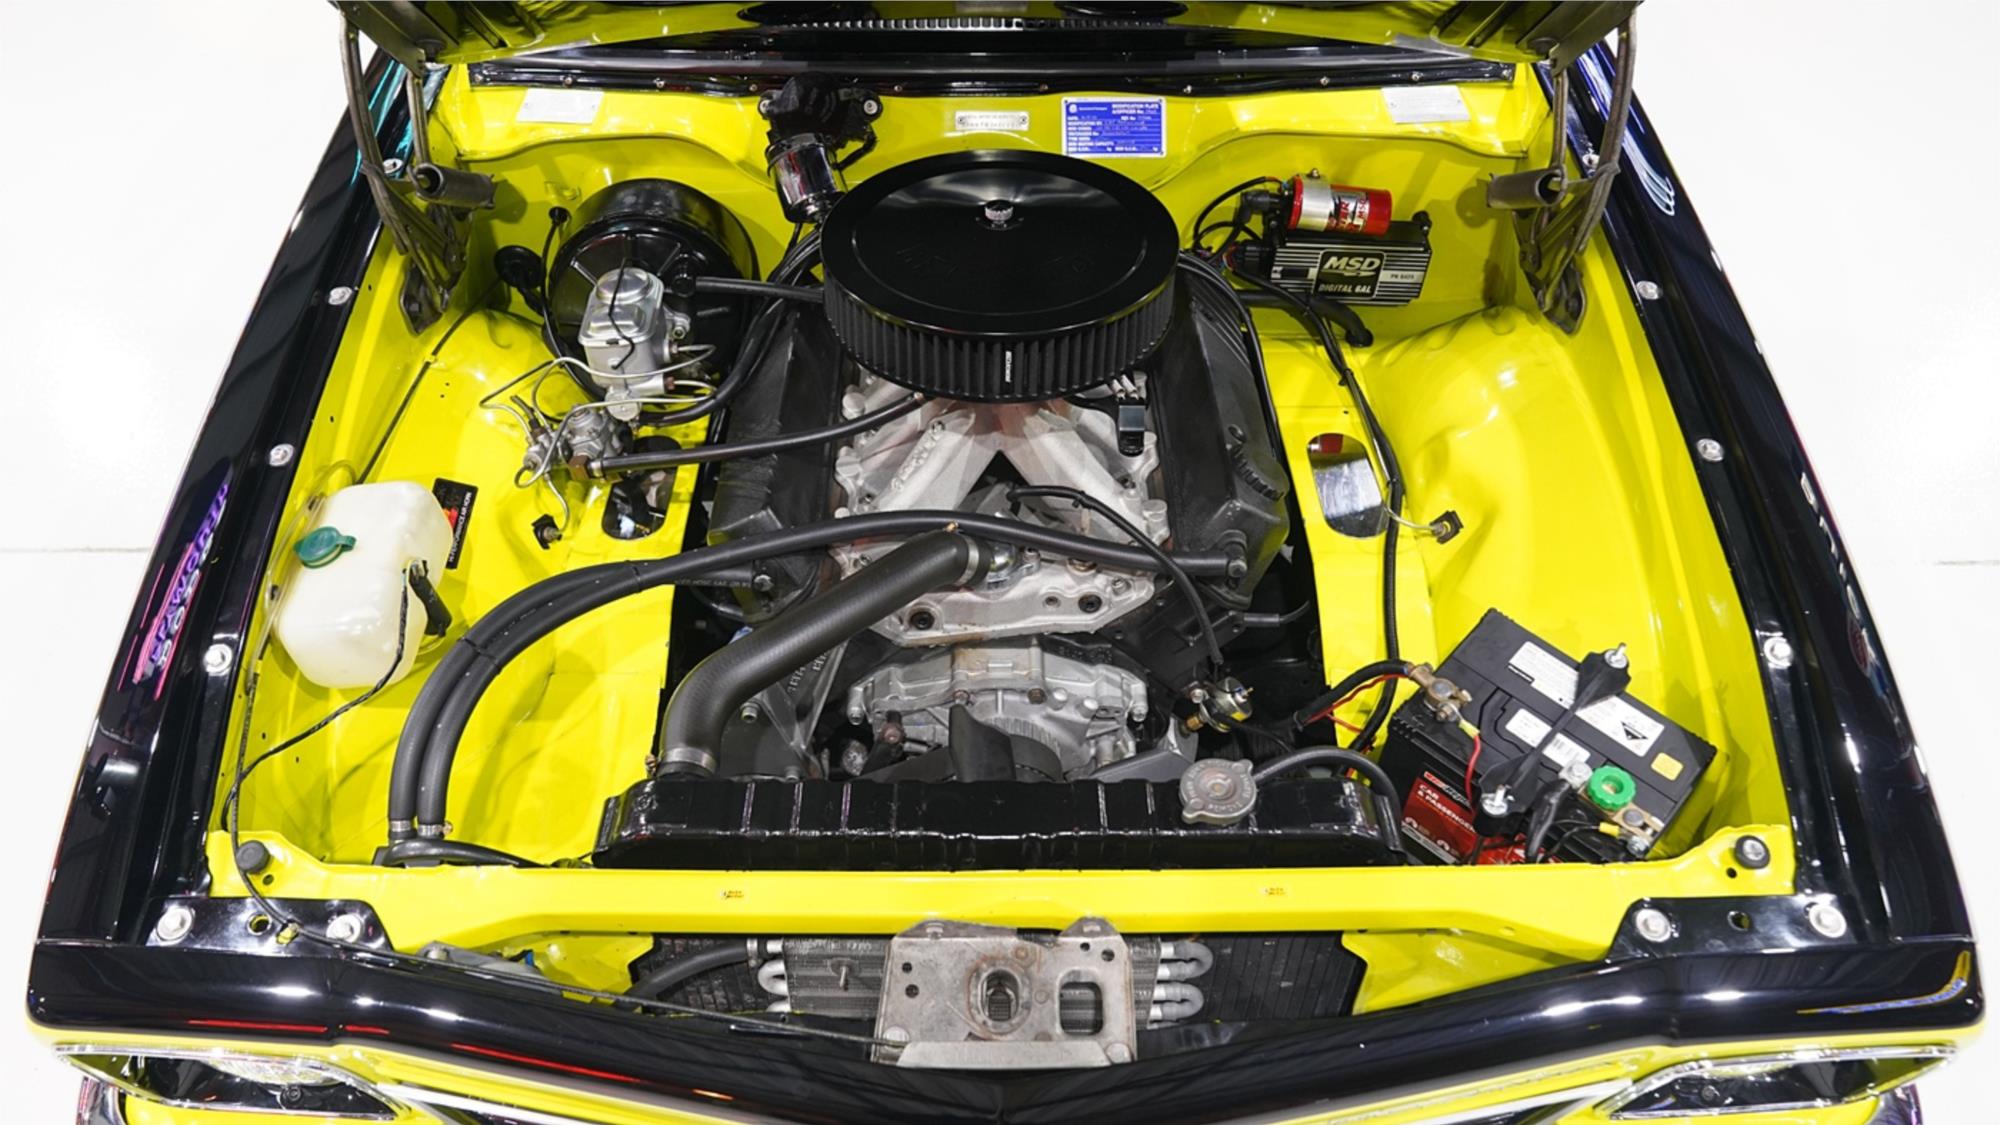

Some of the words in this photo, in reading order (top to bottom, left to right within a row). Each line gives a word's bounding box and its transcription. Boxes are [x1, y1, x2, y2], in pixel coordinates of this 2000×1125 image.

[1323, 256, 1380, 271] MSD
[1319, 284, 1353, 293] DIGITAL
[1354, 284, 1372, 293] 6AL
[1419, 784, 1440, 800] CAR
